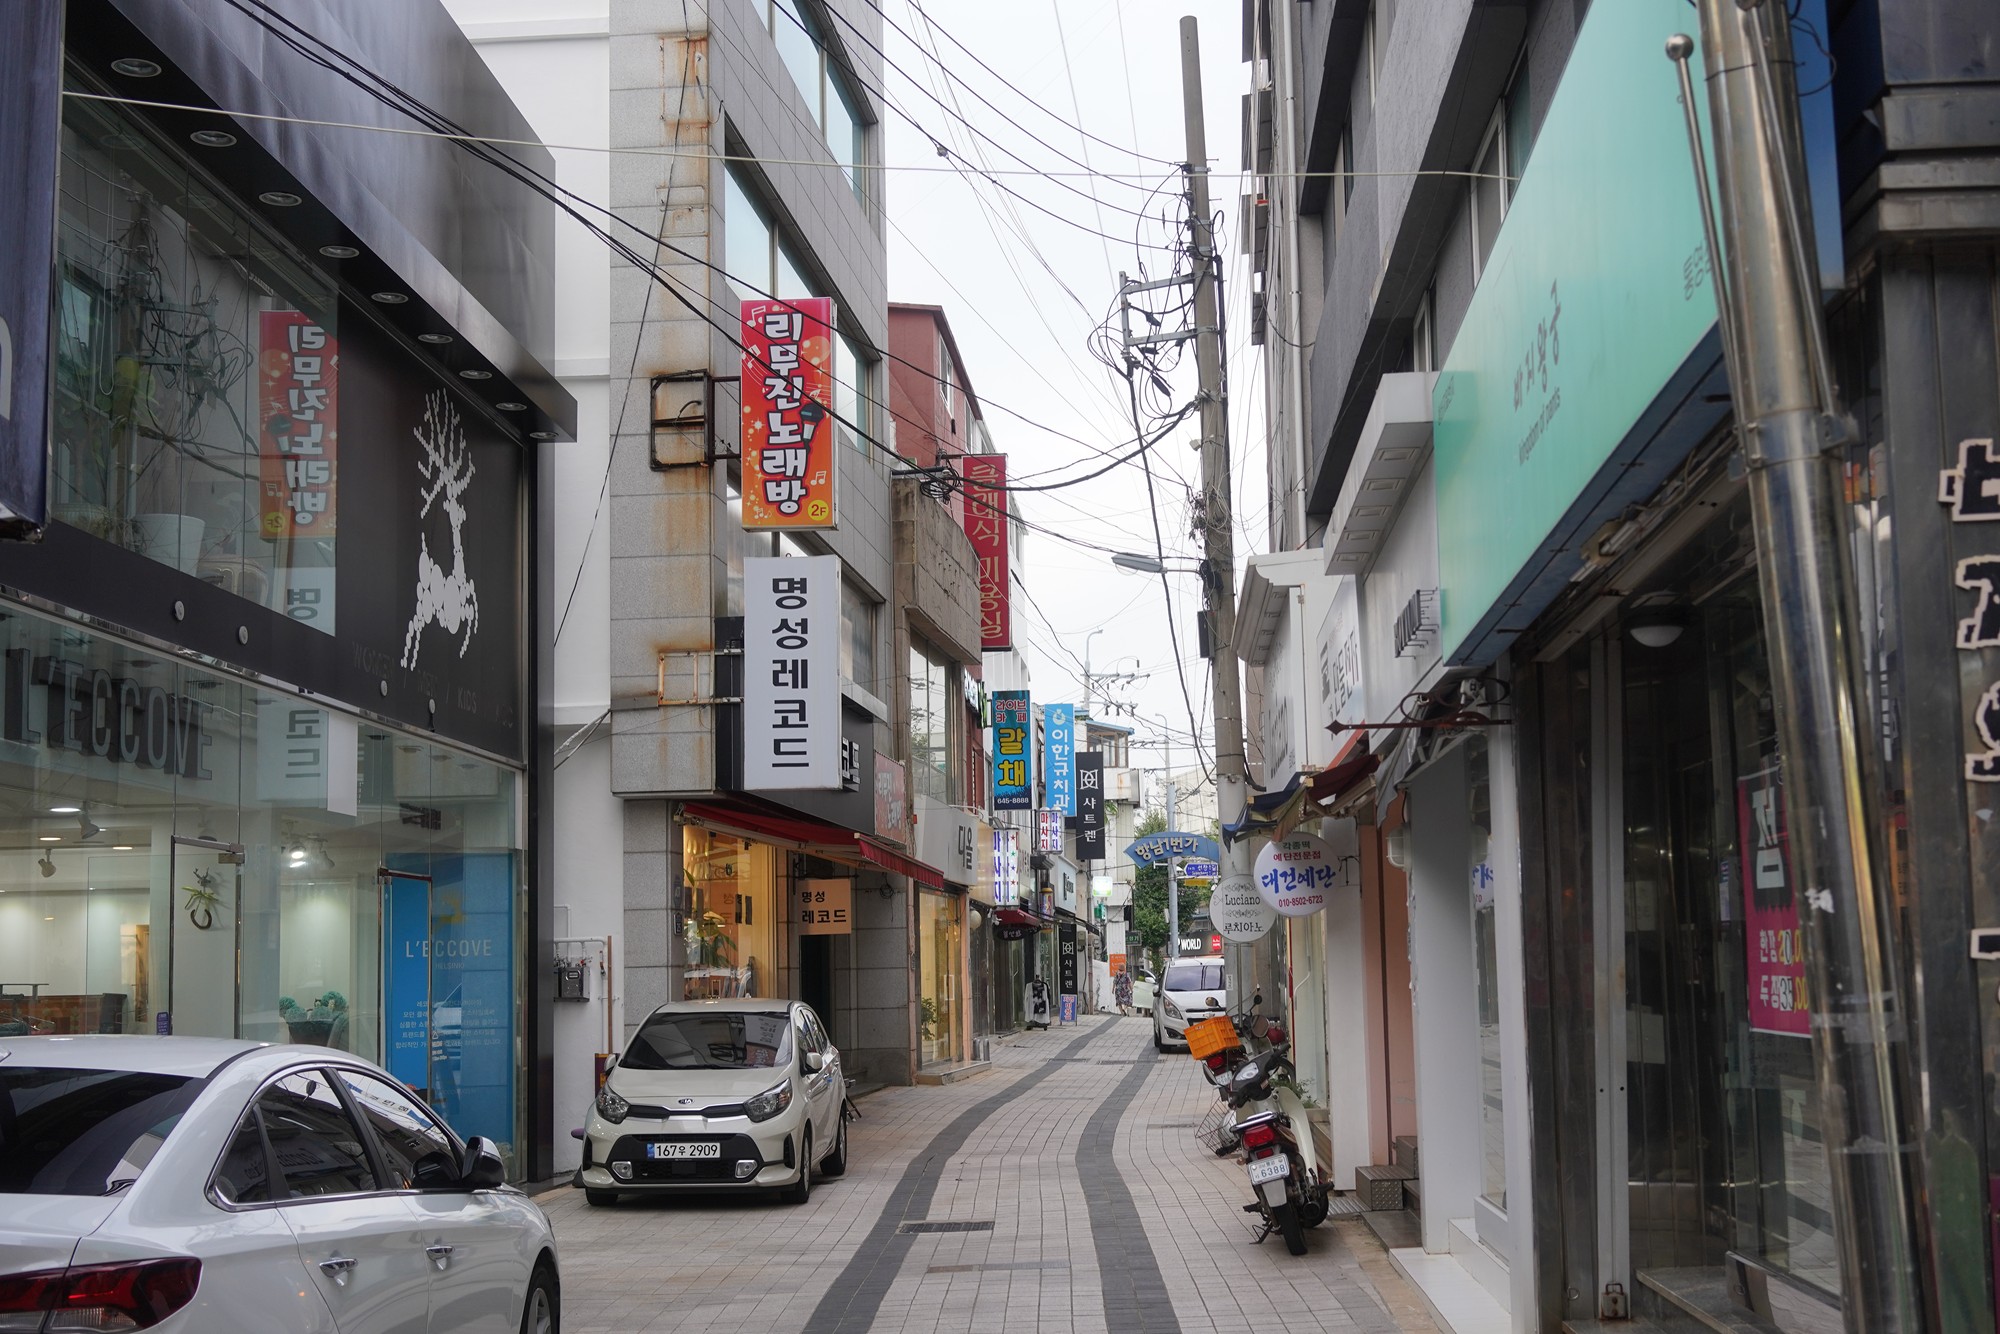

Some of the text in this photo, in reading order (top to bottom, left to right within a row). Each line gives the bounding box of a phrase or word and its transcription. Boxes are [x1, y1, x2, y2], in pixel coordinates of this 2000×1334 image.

[761, 311, 810, 515] 리무진노래방
[809, 502, 828, 517] 2F
[969, 463, 999, 547] 클래식
[771, 576, 810, 769] 명성레코드
[457, 687, 477, 714] KIDS
[995, 699, 1027, 712] 라이브
[997, 727, 1027, 788] 갈채
[1051, 729, 1071, 808] 이한규치과
[1041, 812, 1049, 851] 마사지
[1083, 796, 1097, 843] 샤트렌
[957, 824, 973, 871] 디올
[1135, 837, 1199, 861] 항남1번가
[1261, 864, 1337, 894] 대건예단
[802, 890, 826, 904] 명성
[1225, 893, 1261, 906] Luciano
[1278, 895, 1324, 908] 010-8502-6723
[802, 909, 847, 924] 레코드
[1223, 921, 1265, 935] 루치아노
[1180, 937, 1202, 951] WORLD
[1064, 959, 1073, 989] 샤트렌
[656, 1144, 718, 1157] 167우 2909
[1260, 1164, 1286, 1178] 6388
